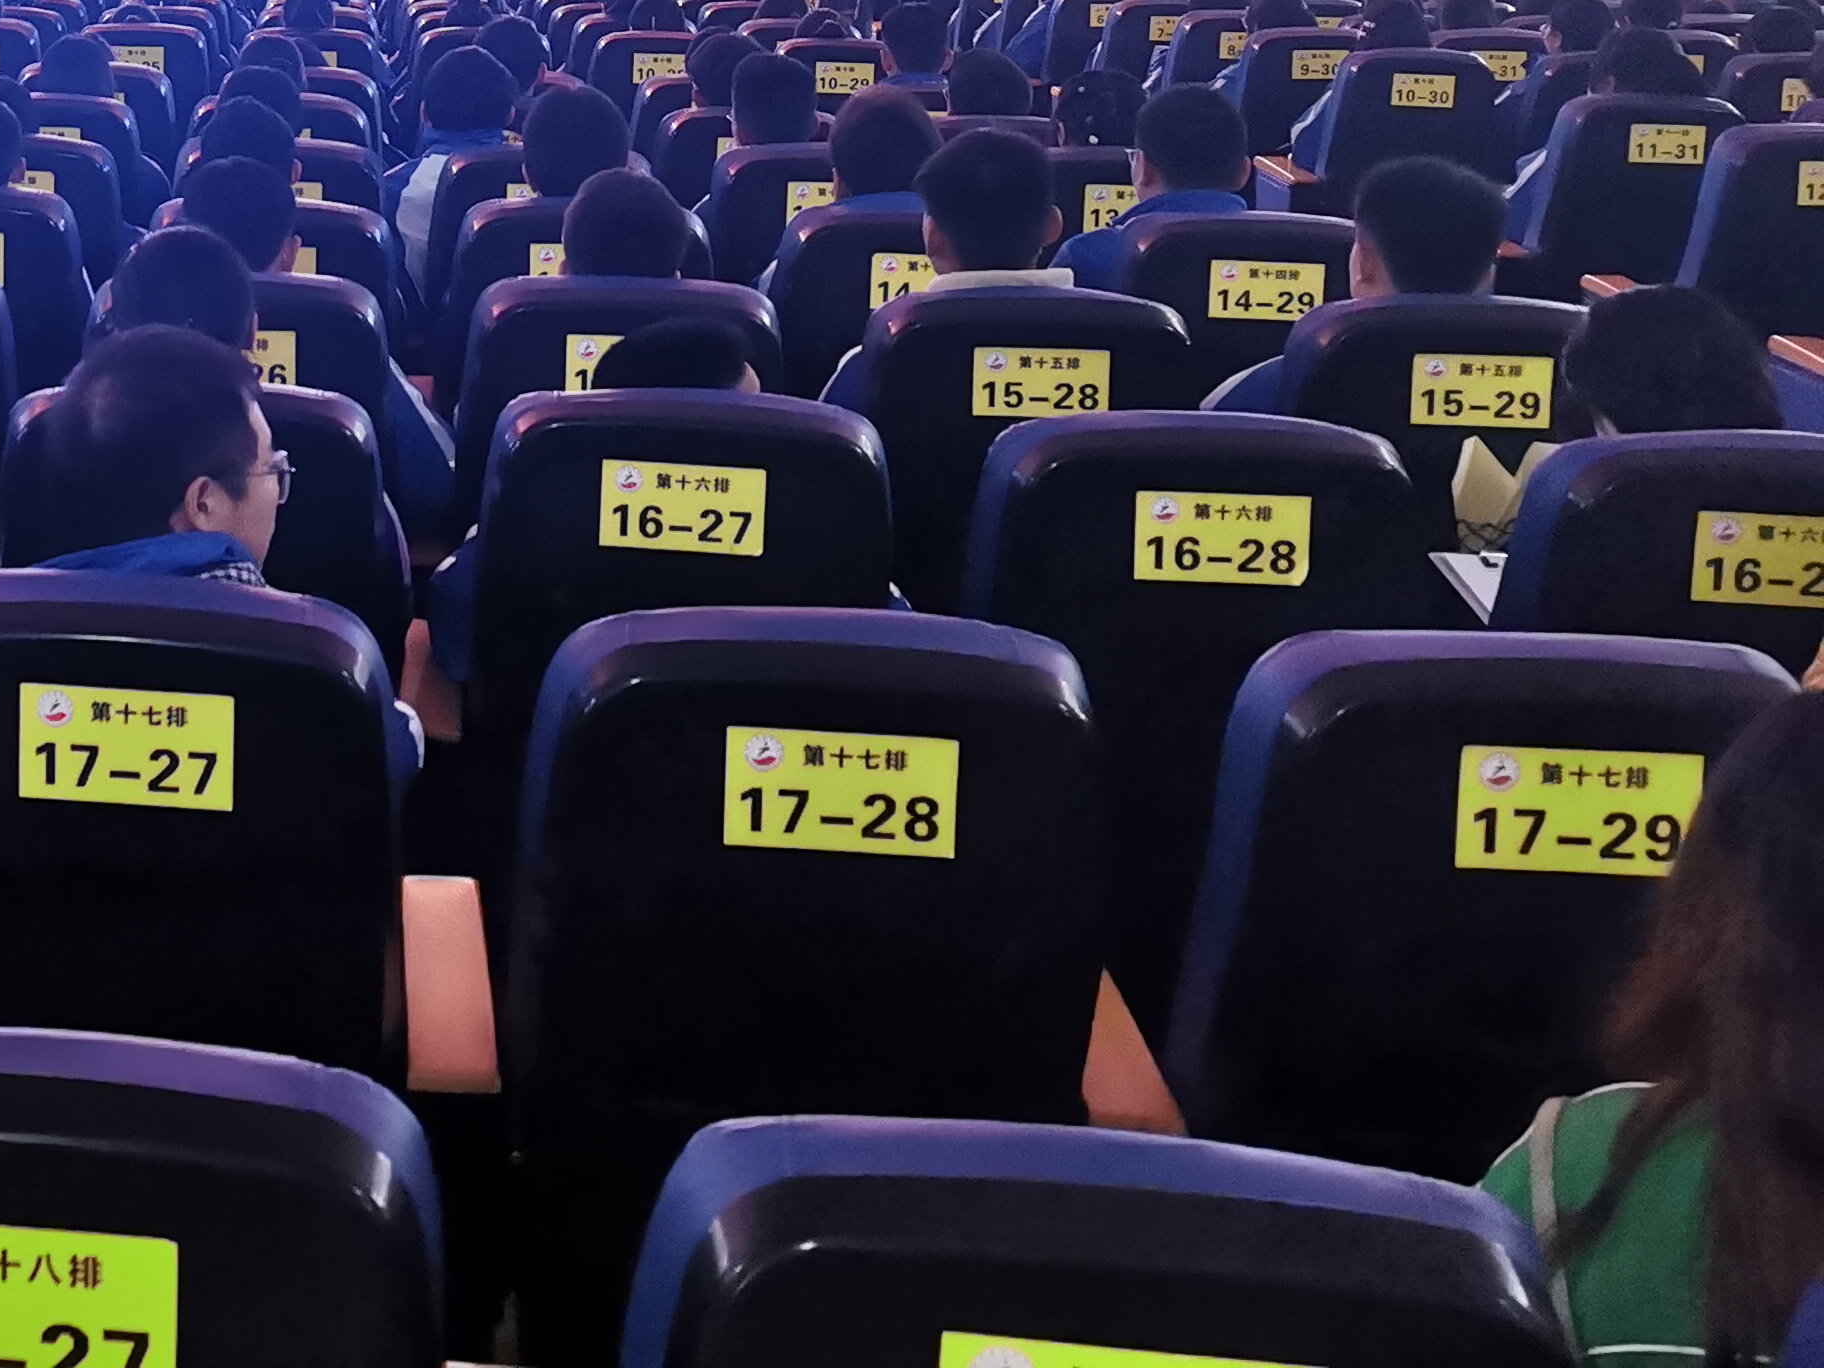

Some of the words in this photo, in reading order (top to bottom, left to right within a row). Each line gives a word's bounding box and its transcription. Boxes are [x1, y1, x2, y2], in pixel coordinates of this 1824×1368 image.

[1396, 89, 1449, 104] 10-30
[1636, 144, 1699, 160] 11-31
[1217, 289, 1315, 313] 14-29
[981, 381, 1100, 411] 15-28
[1420, 389, 1541, 420] 15-29
[611, 503, 753, 546] 16-27
[1145, 535, 1297, 576] 16-28
[90, 699, 189, 730] 第十七排
[33, 741, 219, 796] 17-27
[802, 742, 909, 773] 第十七排
[1540, 762, 1650, 791] 第十七排
[739, 786, 941, 843] 17-28
[1474, 806, 1682, 863] 17-29
